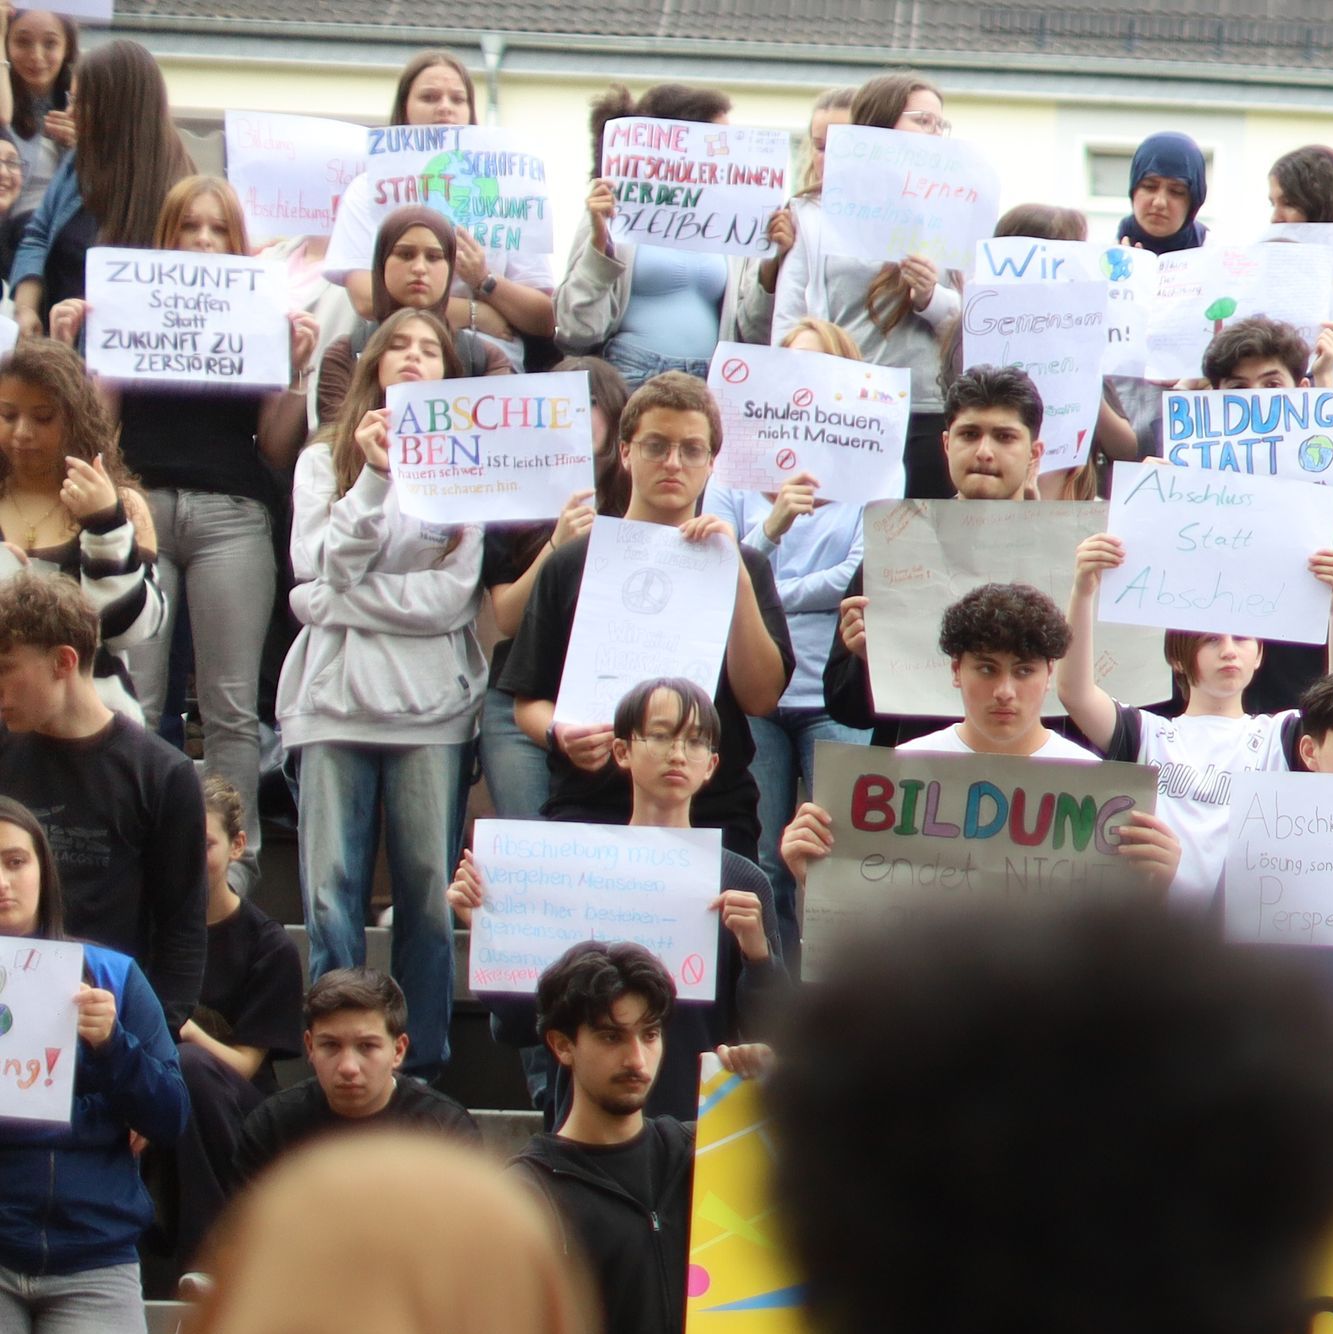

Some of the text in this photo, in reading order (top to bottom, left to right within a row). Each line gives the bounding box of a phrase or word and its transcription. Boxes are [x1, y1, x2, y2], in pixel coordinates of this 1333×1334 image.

[367, 126, 464, 155] ZUKUNFT
[608, 122, 690, 153] MEINE
[374, 173, 456, 205] STATT
[901, 170, 979, 203] Lernen
[452, 196, 548, 220] ZUKUNFT
[105, 261, 265, 291] ZUKUNFT
[148, 289, 231, 312] Schaffen
[162, 311, 207, 328] Statt
[101, 329, 244, 354] ZUKUNFT ZU
[743, 400, 810, 421] Schulen
[757, 424, 799, 440] nicht
[397, 433, 482, 466] BEN
[1175, 521, 1254, 552] Statt
[850, 773, 1137, 856] BILDUNG
[859, 847, 976, 890] endet
